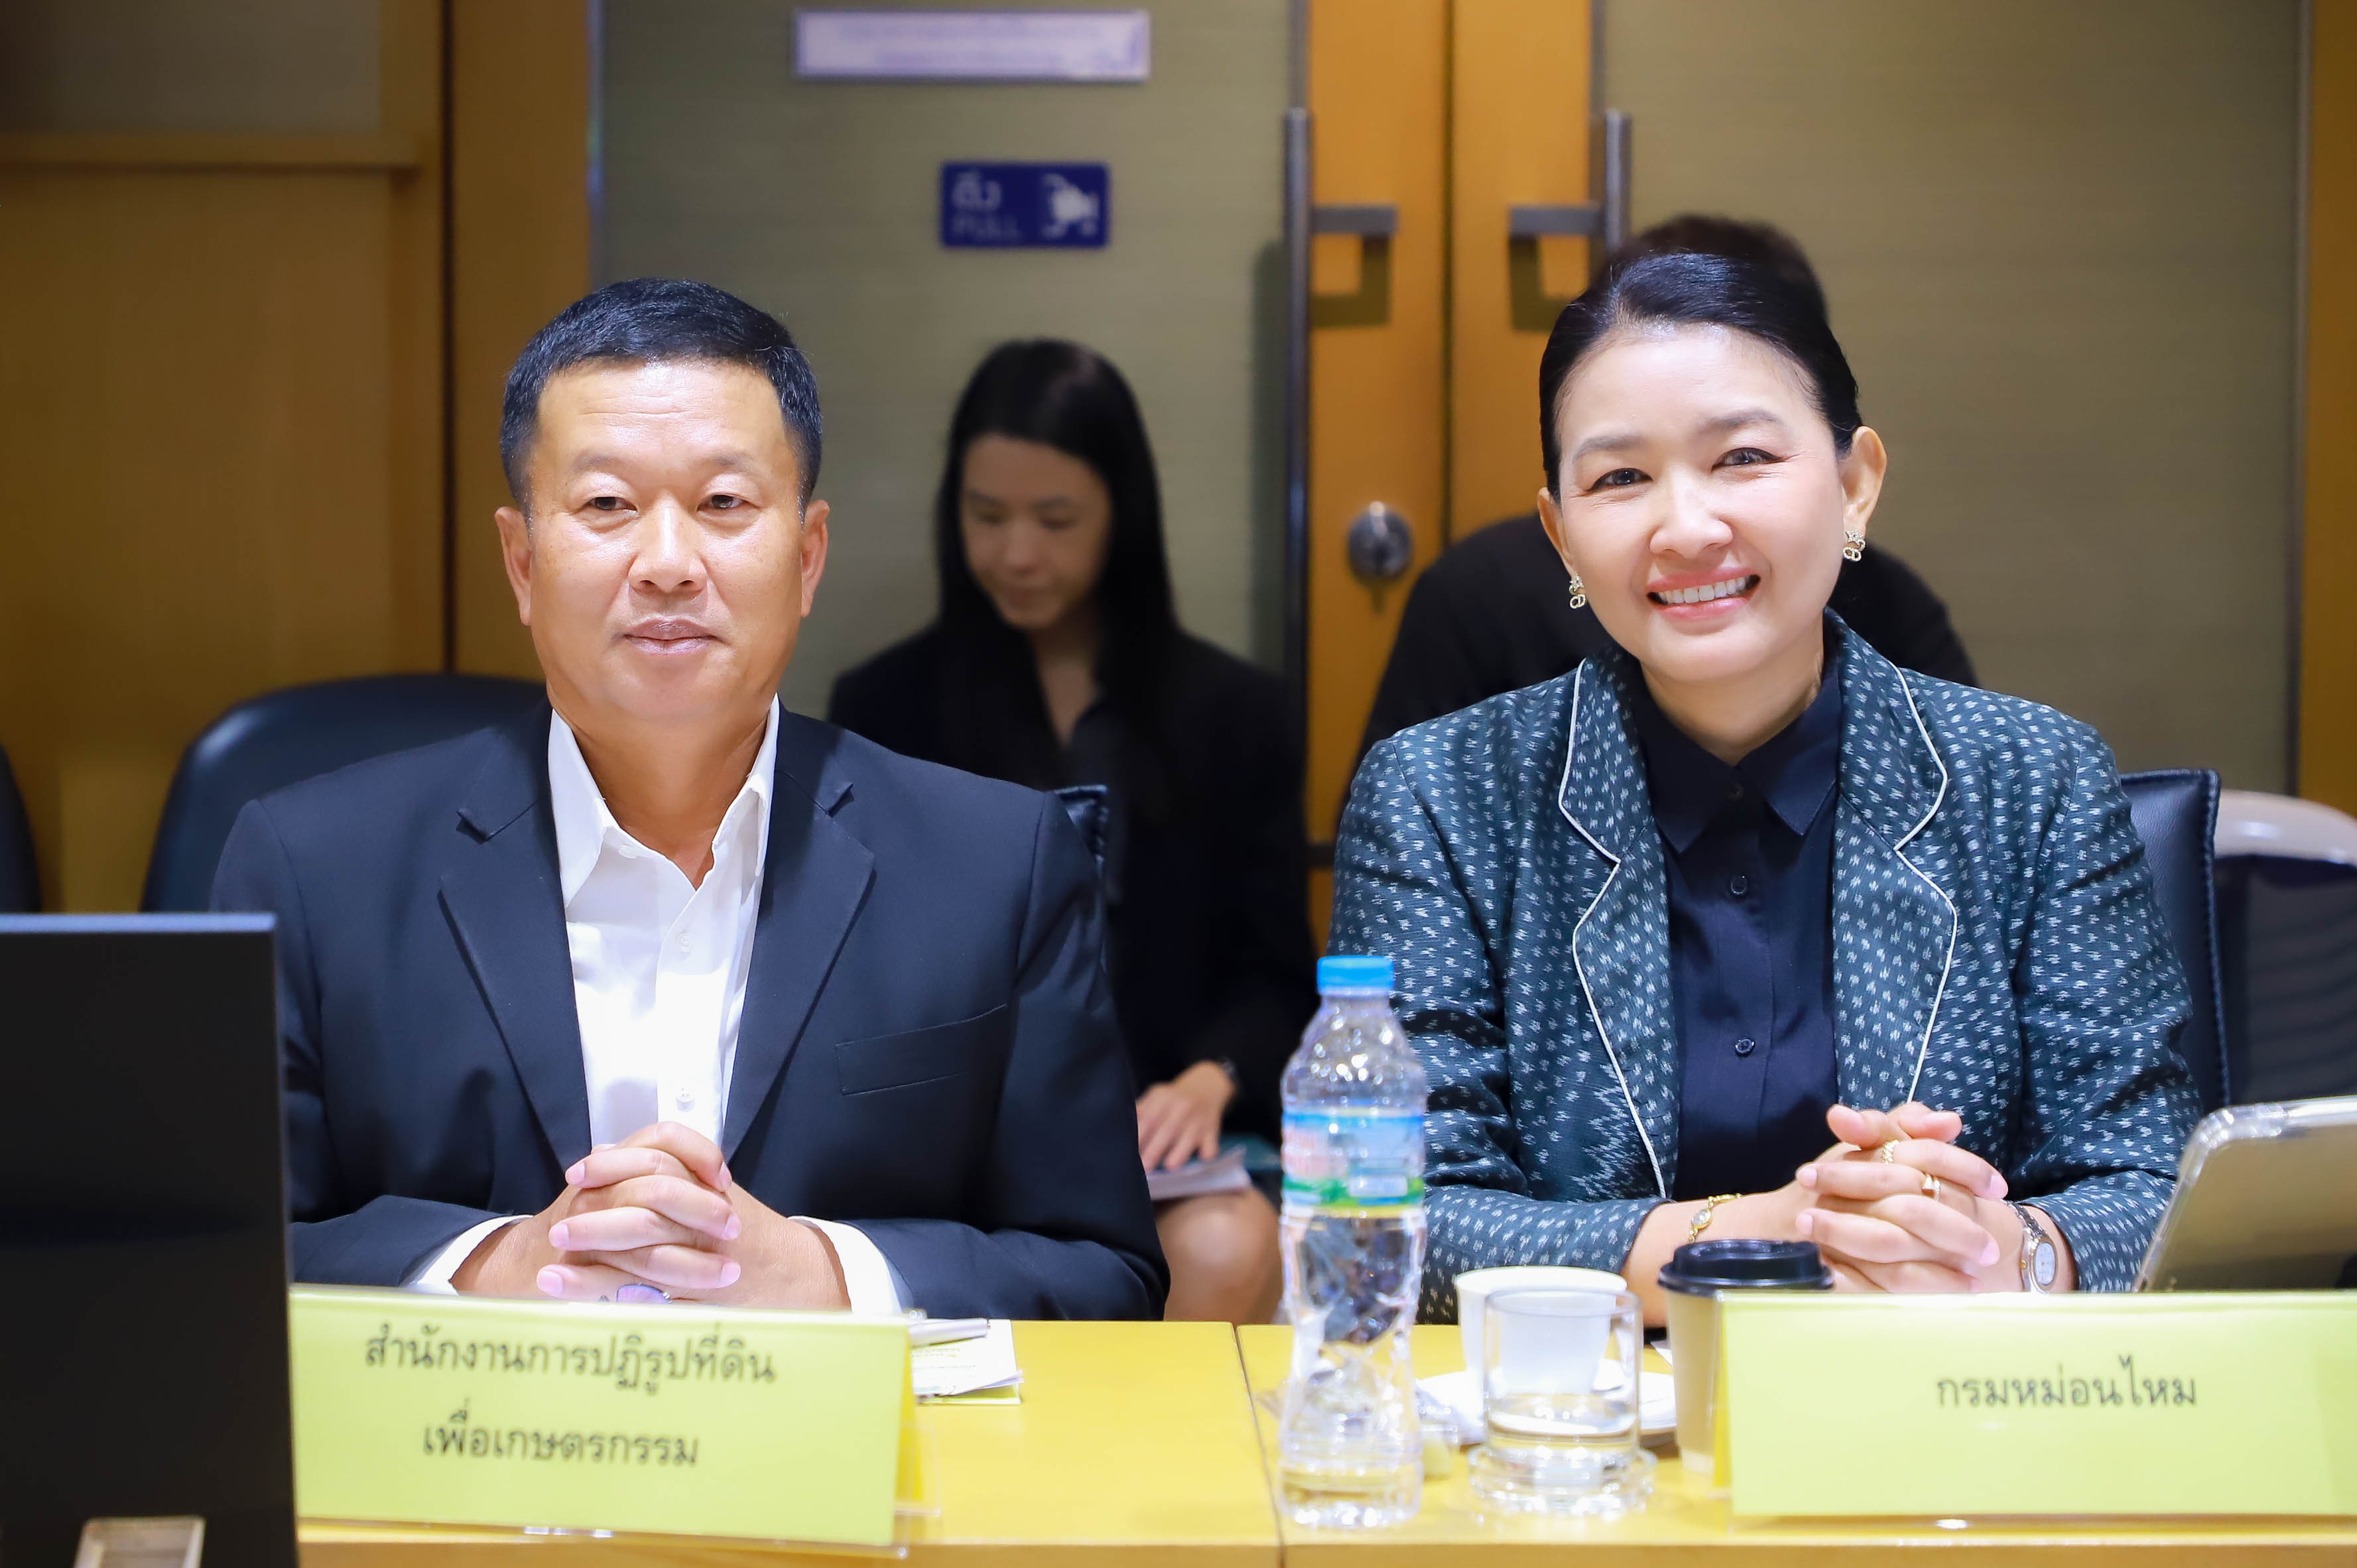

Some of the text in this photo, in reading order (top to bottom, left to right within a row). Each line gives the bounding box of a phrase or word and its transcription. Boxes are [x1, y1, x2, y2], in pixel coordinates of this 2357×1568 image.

[365, 1321, 775, 1395] สำนักงานการปฏิรูปที่ดิน
[1937, 1353, 2197, 1406] กรมหม่อนไหม
[423, 1397, 698, 1465] เพื่อเกษตรกรรม
